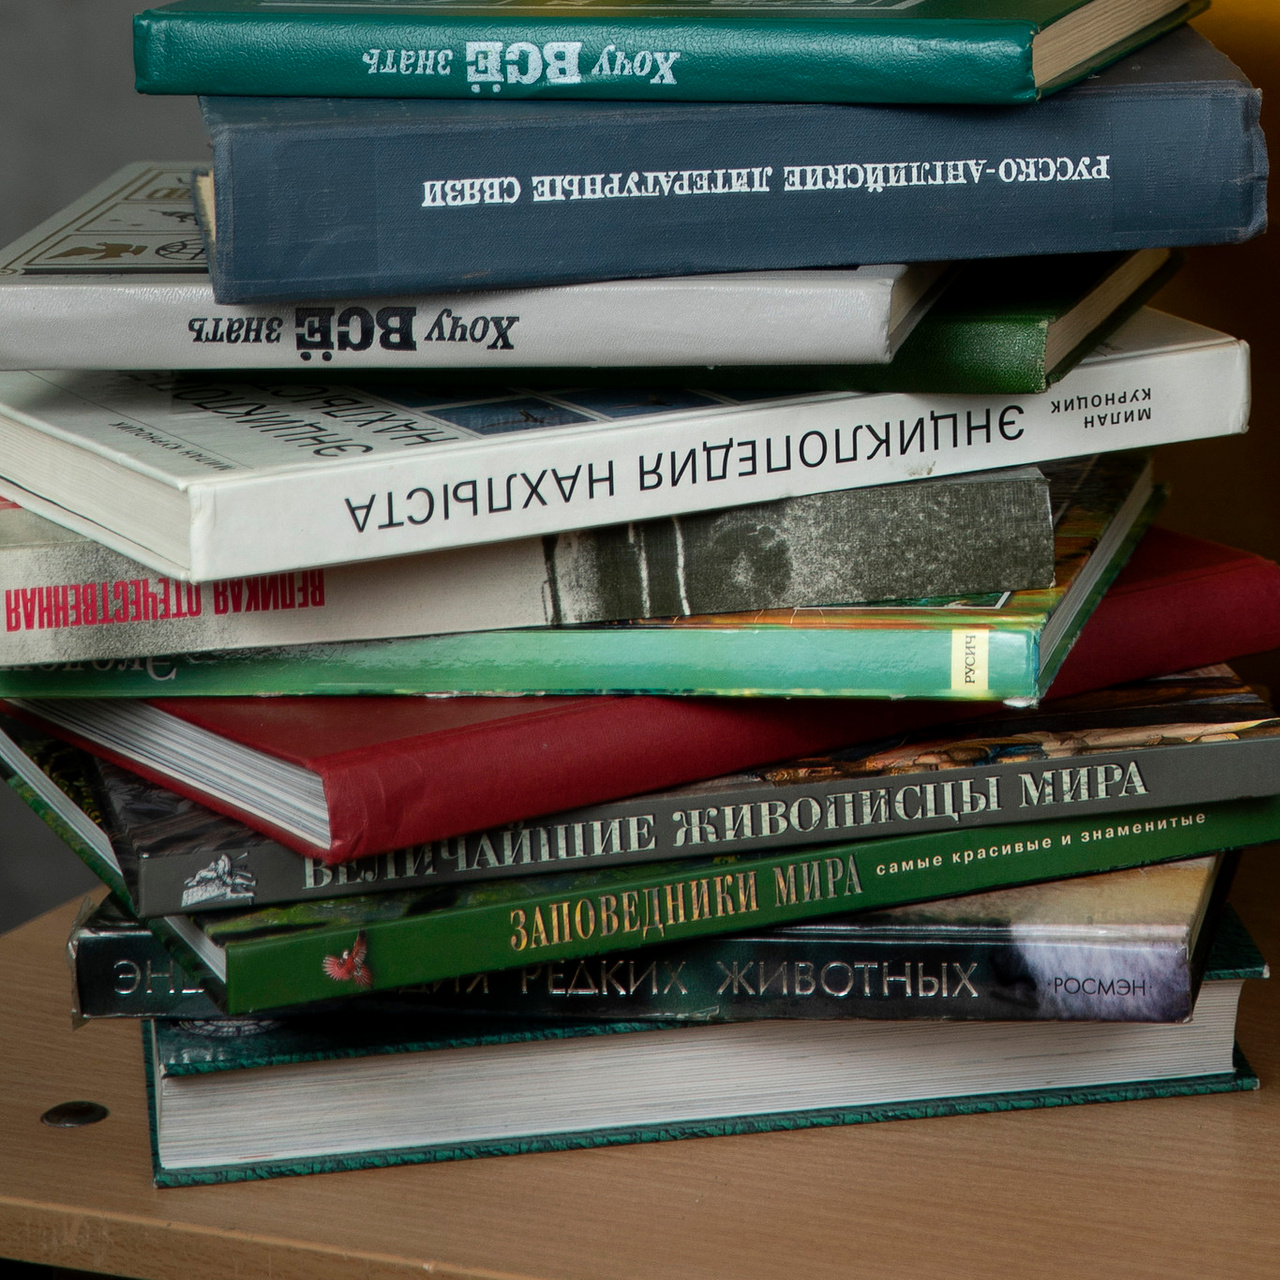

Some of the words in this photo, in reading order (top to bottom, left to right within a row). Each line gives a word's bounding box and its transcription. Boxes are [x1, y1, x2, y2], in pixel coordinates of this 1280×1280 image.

[362, 48, 453, 75] знать
[466, 41, 582, 93] ВСЁ
[592, 44, 681, 85] Хочу
[421, 176, 521, 207] СВЯЗИ
[531, 167, 773, 202] ЛИТЕРАТУРНЫЕ
[783, 155, 1110, 193] РУССКО-АНГЛИЙСКИЕ
[188, 316, 284, 344] знать
[295, 306, 417, 362] ВСЁ
[424, 308, 520, 350] Хочу
[1050, 387, 1152, 414] КУРНОЦИК
[1084, 407, 1152, 429] МИЛАН
[639, 405, 1026, 492] ЭНЦИКЛОПЕДИЯ
[344, 460, 614, 533] НАХЛЫСТА
[5, 578, 202, 633] ОТЕЧЕСТВЕННАЯ
[964, 635, 976, 685] РУСИЧ
[672, 776, 1003, 848] ЖИВОПИСЦЫ
[1018, 761, 1149, 808] МИРА
[876, 855, 943, 877] самые
[952, 838, 1052, 864] красивые
[1061, 834, 1072, 846] и
[1081, 812, 1206, 843] знаменитые
[510, 870, 760, 952] ЗАПОВЕДНИКИ
[772, 854, 864, 908] МИРА
[716, 960, 979, 999] ЖИВОТНЫХ
